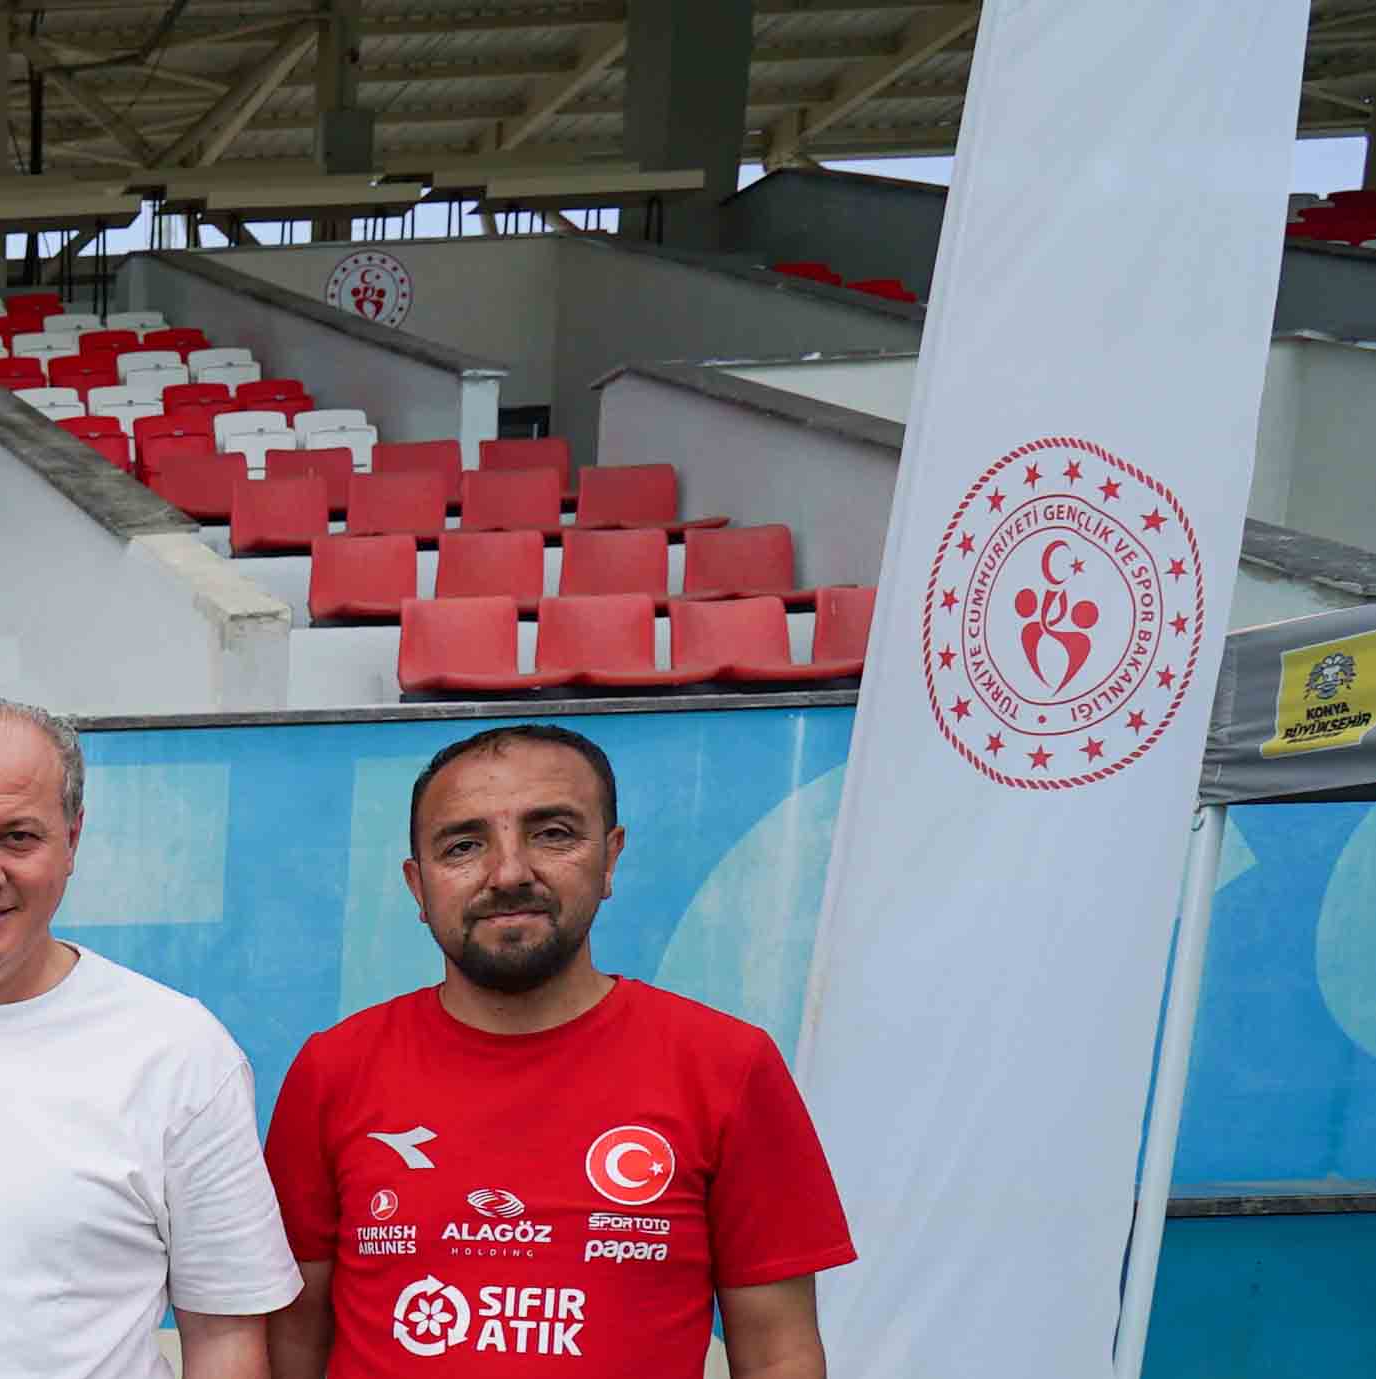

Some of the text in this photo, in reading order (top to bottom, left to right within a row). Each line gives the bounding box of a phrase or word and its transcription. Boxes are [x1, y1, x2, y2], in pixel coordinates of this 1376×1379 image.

[969, 505, 1154, 722] TÜRKİYE CUMHURİYETİ GENÇLİK VE SPOR BAKANLIĞI
[1306, 702, 1350, 720] KONYA
[357, 1225, 416, 1240] TURKISH
[442, 1220, 552, 1243] ALAGÖZ
[359, 1241, 416, 1255] AIRLINES
[451, 1247, 534, 1257] HOLDING
[584, 1240, 668, 1264] papara
[478, 1285, 586, 1321] SIFIR
[476, 1319, 584, 1357] ATIK
